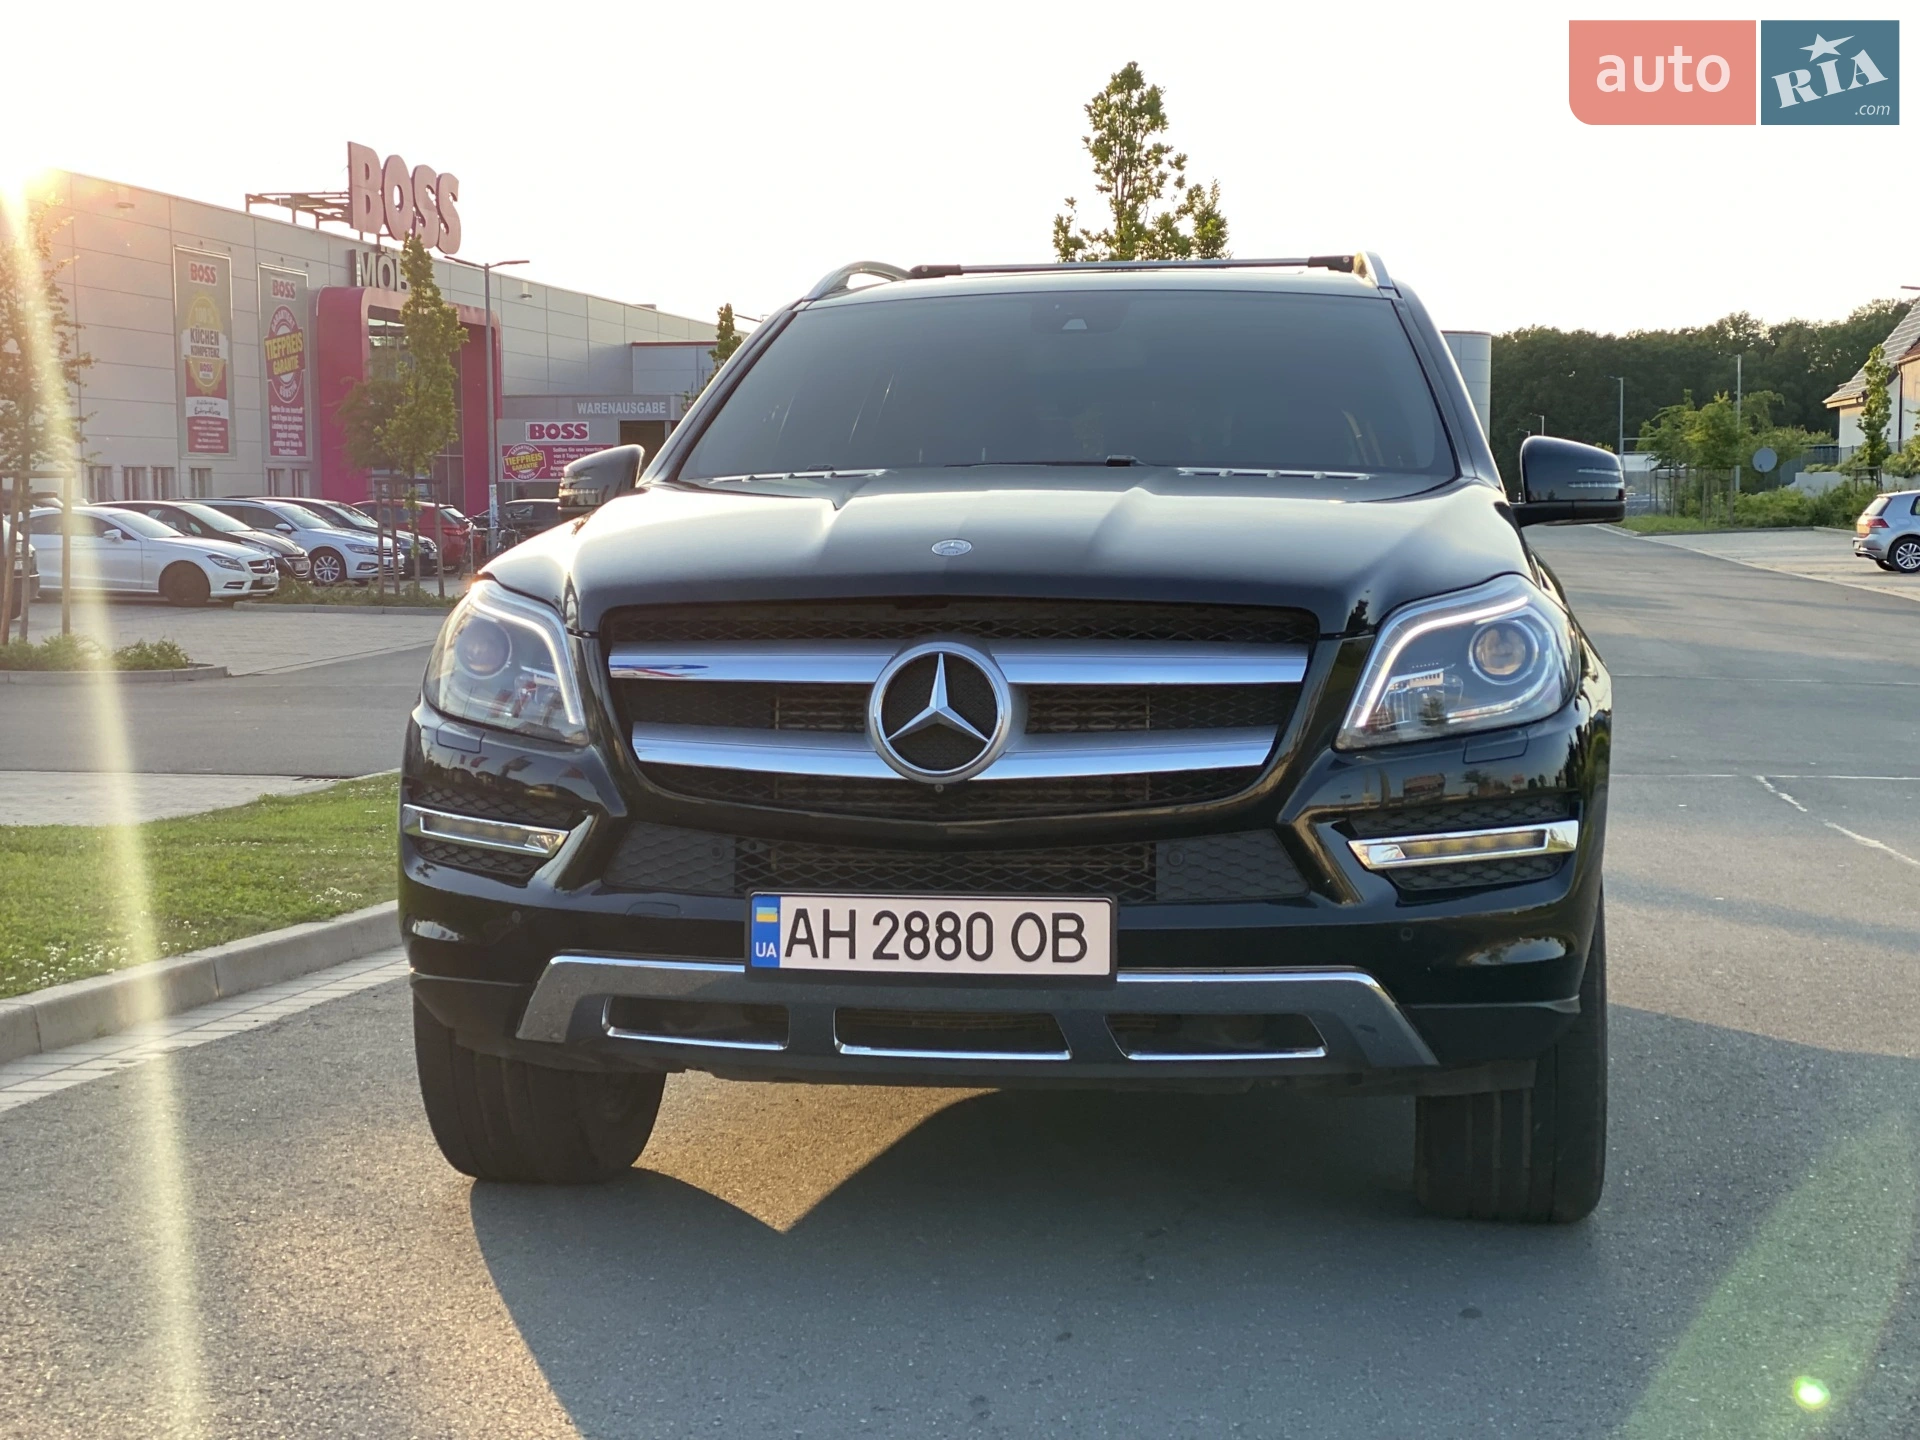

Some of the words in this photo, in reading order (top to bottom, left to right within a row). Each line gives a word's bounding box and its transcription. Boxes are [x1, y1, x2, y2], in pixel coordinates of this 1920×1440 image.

[347, 141, 462, 255] BOSS
[190, 263, 217, 285] BOSS
[272, 279, 296, 300] BOSS
[190, 325, 220, 346] KÜCHEN
[190, 345, 220, 359] KOMPETENZ
[265, 331, 303, 361] TIEFPREIS
[272, 355, 299, 375] GARANTIE
[577, 402, 666, 414] WARENAUSGABE
[529, 423, 588, 440] BOSS
[504, 452, 543, 466] TIEFPREIS
[511, 462, 539, 472] GARANTIE
[784, 908, 857, 960] AH
[872, 910, 994, 962] 2880
[1011, 911, 1088, 963] OB
[755, 942, 777, 958] UA
